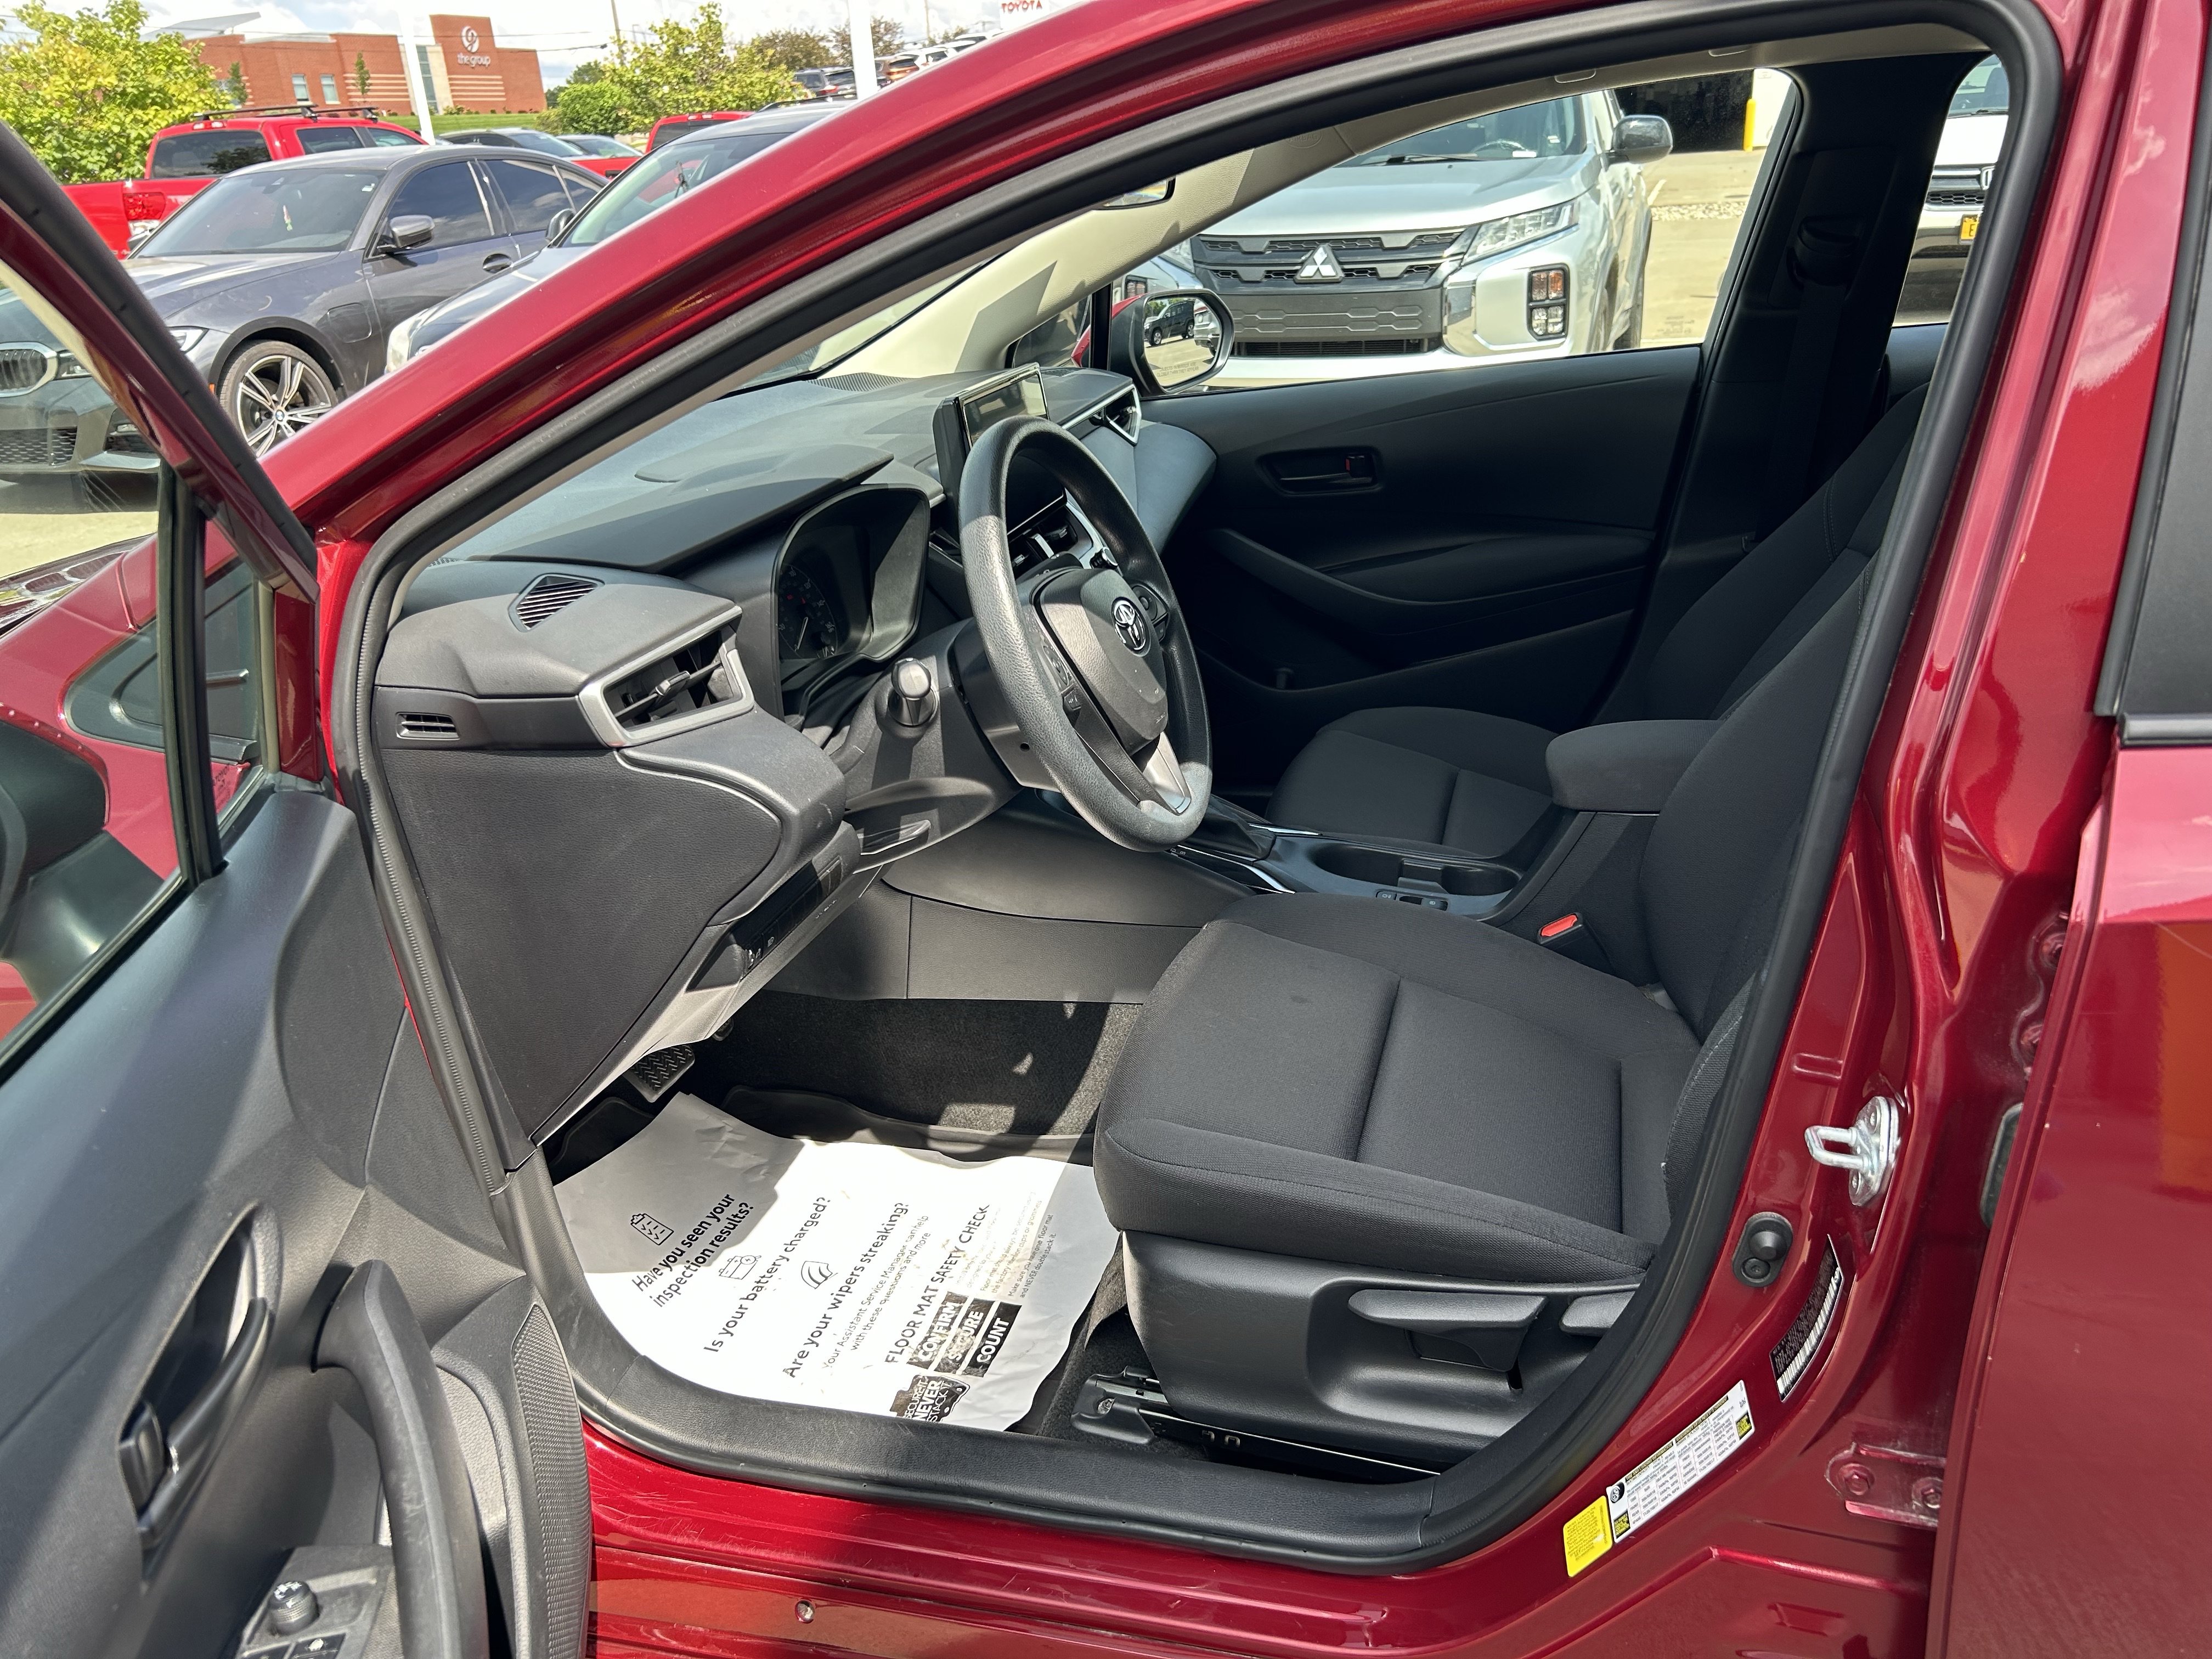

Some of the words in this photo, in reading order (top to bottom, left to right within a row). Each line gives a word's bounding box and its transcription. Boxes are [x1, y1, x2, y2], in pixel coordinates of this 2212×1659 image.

[1001, 0, 1042, 13] TOYOTA
[632, 1267, 664, 1291] Have
[658, 1246, 686, 1272] you
[681, 1220, 712, 1248] seen
[706, 1194, 735, 1222] your
[649, 1247, 715, 1307] inspection
[709, 1202, 754, 1248] results?
[703, 1340, 724, 1352] Is
[718, 1304, 748, 1337] your
[739, 1255, 790, 1301] battery
[783, 1197, 831, 1252] charged?
[1008, 1283, 1020, 1296] Make
[1017, 1270, 1026, 1283] sure
[1038, 1224, 1048, 1240] floor
[1045, 1214, 1054, 1225] mat
[1044, 1239, 1054, 1255] stack
[782, 1350, 809, 1378] Are
[803, 1313, 832, 1347] your
[827, 1265, 865, 1310] wipers
[860, 1203, 909, 1263] streaking?
[837, 1308, 867, 1346] Assistant
[861, 1279, 887, 1306] Service
[881, 1245, 907, 1278] Manager
[850, 1331, 867, 1351] with
[866, 1307, 882, 1330] these
[879, 1265, 907, 1305] questions
[905, 1250, 917, 1265] and
[915, 1232, 931, 1250] more
[884, 1320, 923, 1363] FLOOR
[913, 1285, 939, 1316] MAT
[931, 1245, 964, 1283] SAFETY
[959, 1204, 990, 1243] CHECK
[1020, 1287, 1029, 1298] and
[1024, 1269, 1039, 1288] NEVER
[917, 1302, 960, 1362] CONFIRM
[976, 1317, 1009, 1363] COUNT
[912, 1380, 942, 1420] NEVER
[926, 1390, 949, 1422] STACK
